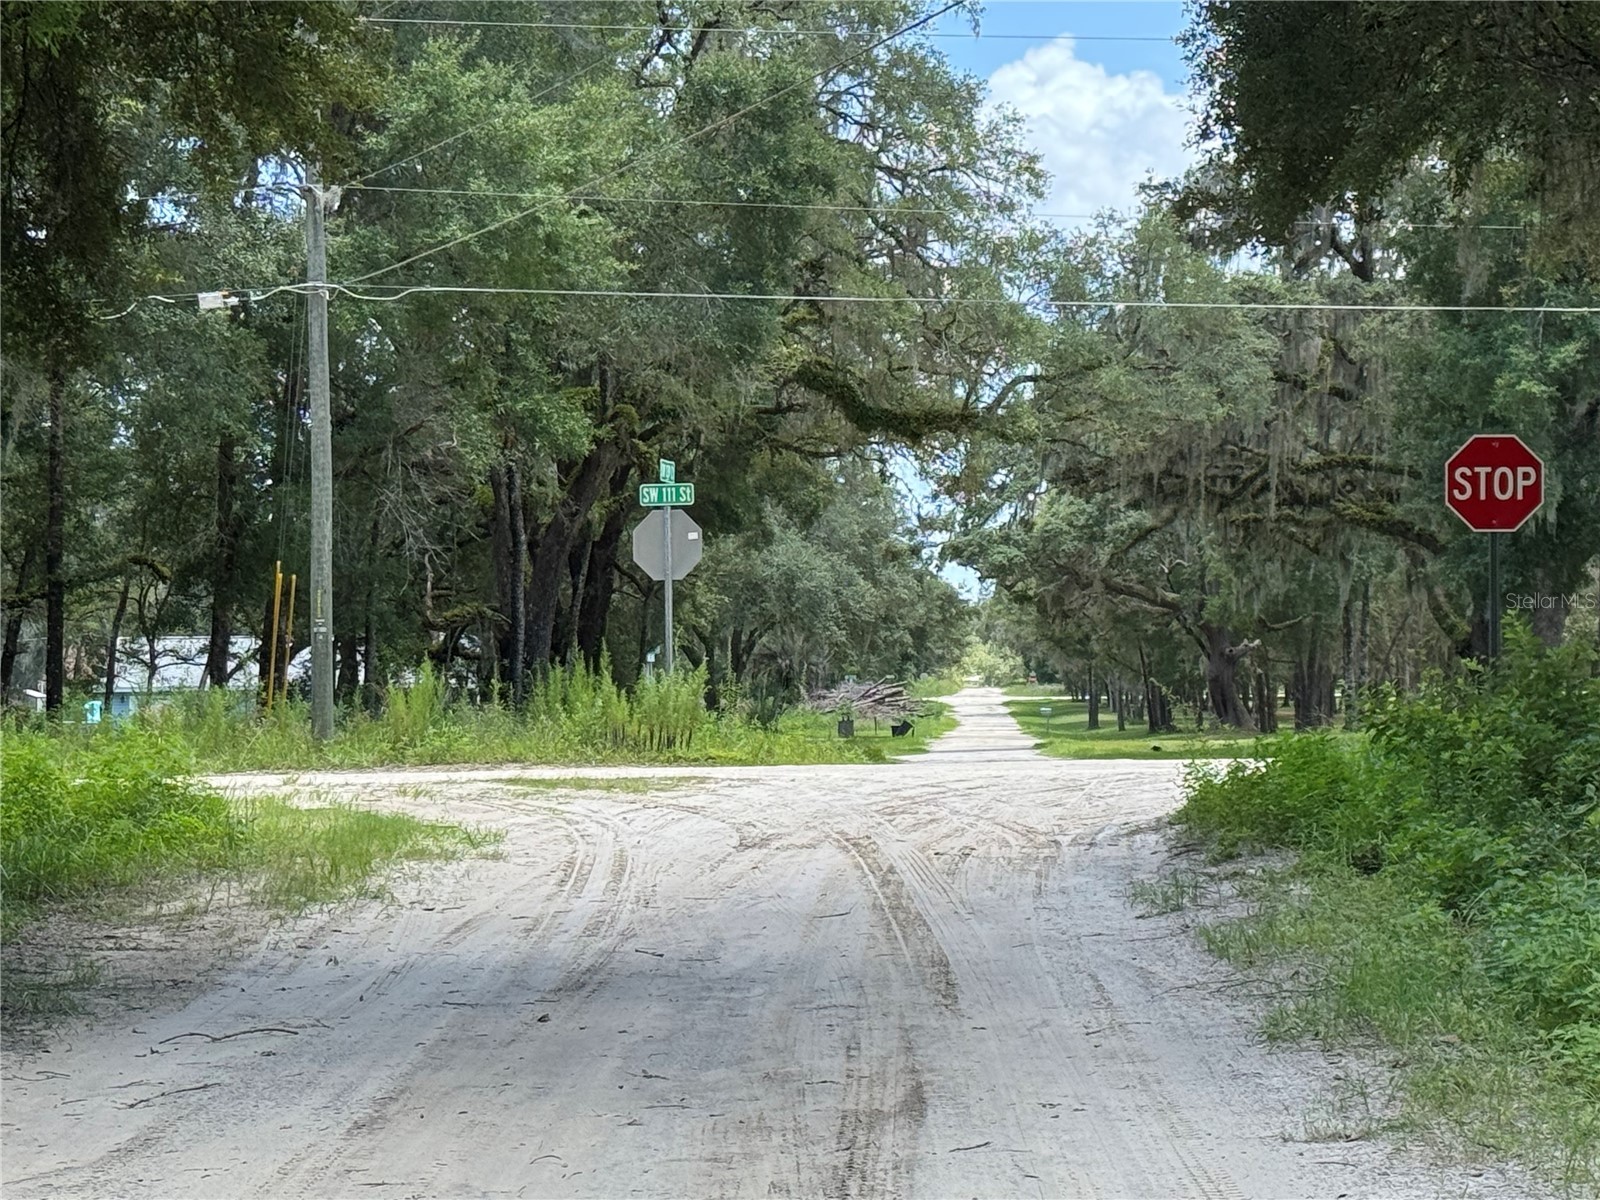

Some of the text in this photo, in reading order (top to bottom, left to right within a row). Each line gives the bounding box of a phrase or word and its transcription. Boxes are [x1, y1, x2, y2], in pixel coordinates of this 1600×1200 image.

[642, 486, 692, 503] SW 111 St
[1453, 466, 1537, 501] STOP
